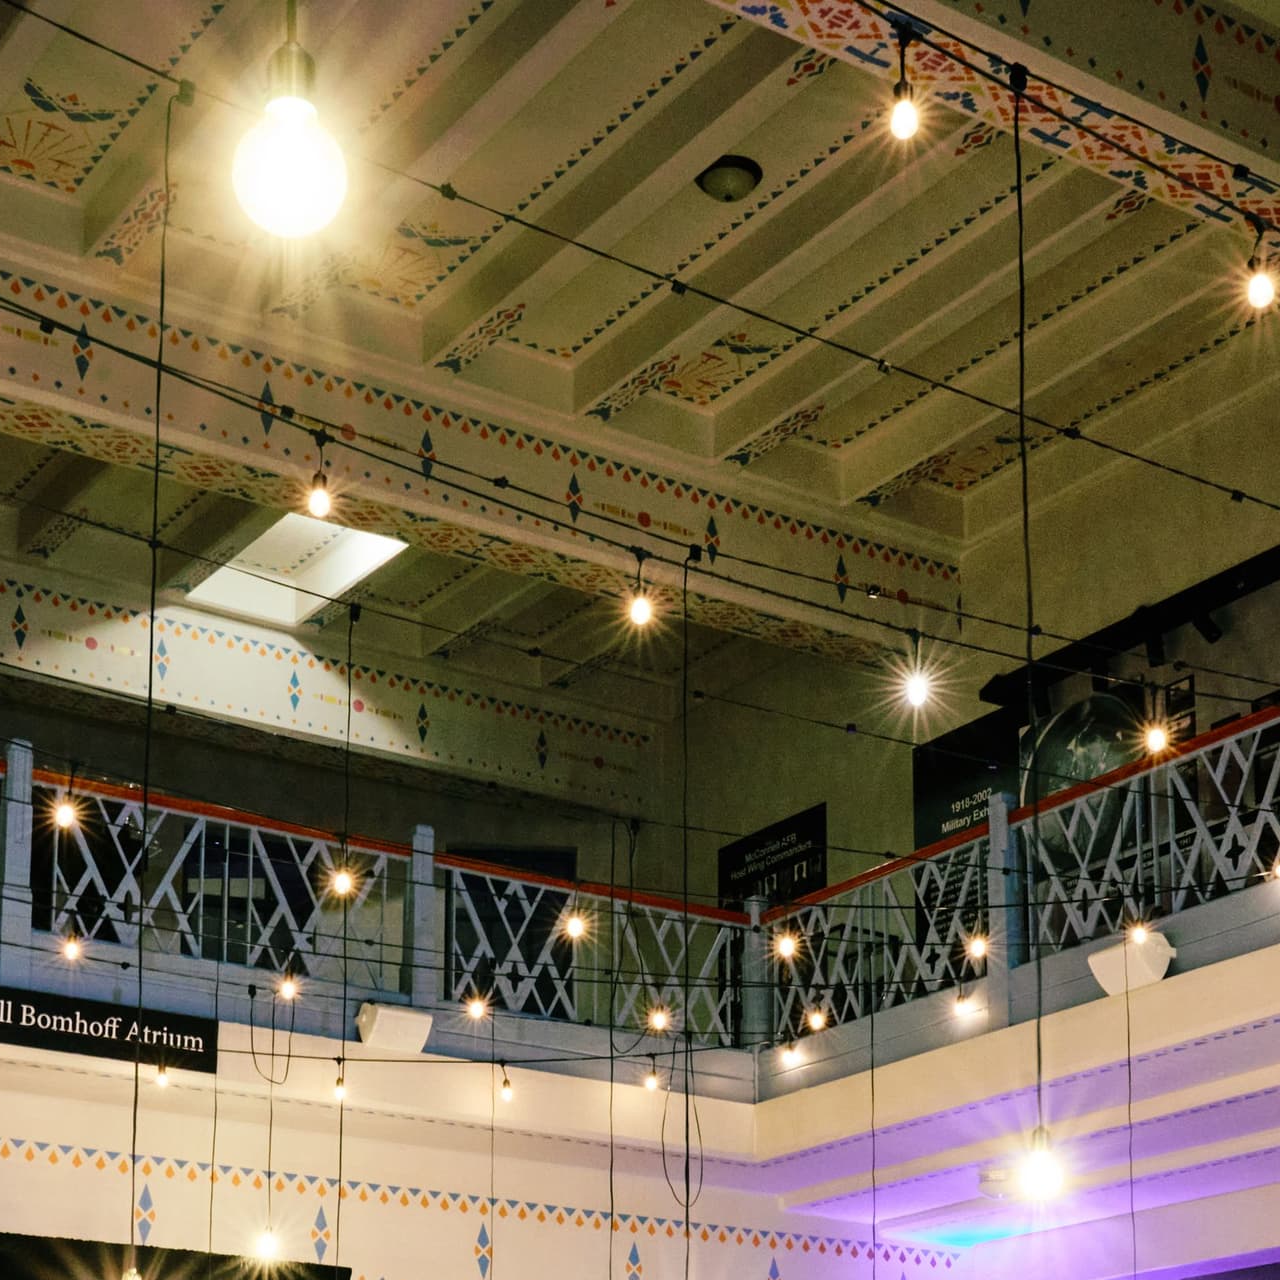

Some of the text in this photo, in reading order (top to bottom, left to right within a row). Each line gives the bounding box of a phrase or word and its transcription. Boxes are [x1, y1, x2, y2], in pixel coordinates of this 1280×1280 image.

[941, 815, 972, 834] Military
[19, 1004, 122, 1041] Bomhoff
[127, 1020, 205, 1053] Atrium
